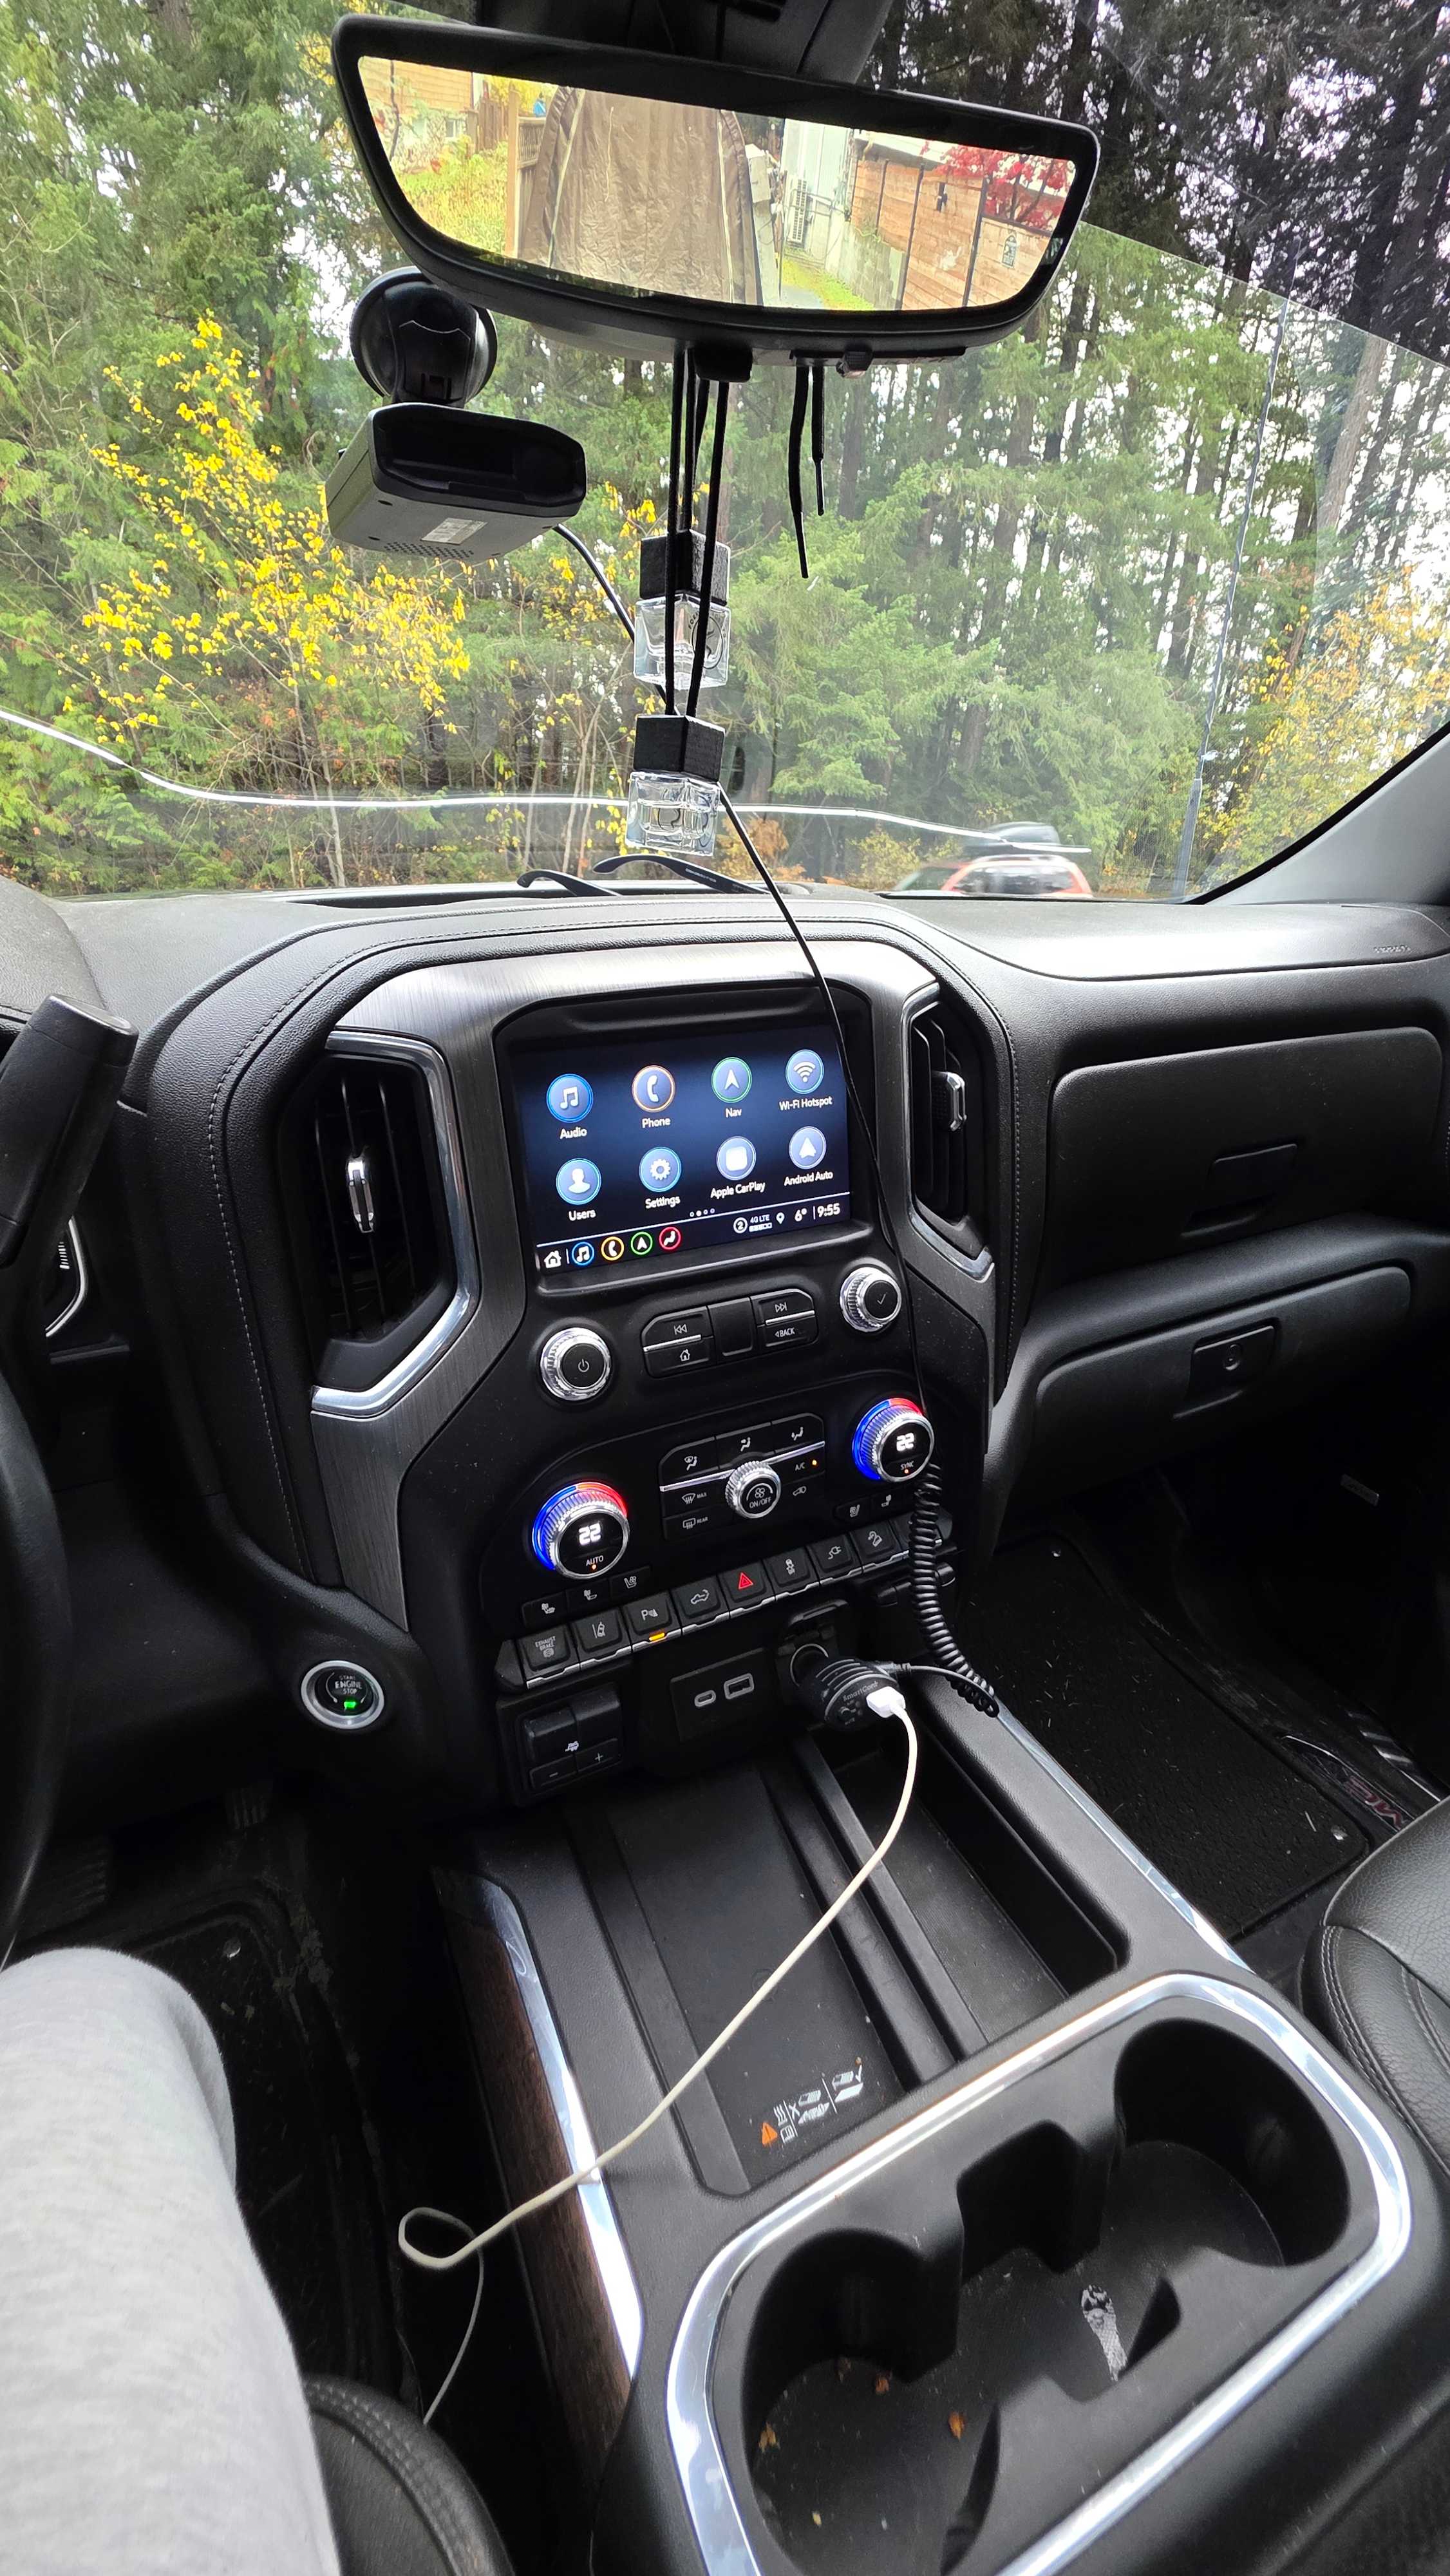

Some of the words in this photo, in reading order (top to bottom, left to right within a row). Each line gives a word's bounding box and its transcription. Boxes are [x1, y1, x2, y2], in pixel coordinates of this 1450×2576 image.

[779, 1099, 800, 1111] Wi-Fi
[801, 1095, 833, 1108] Hotspot
[725, 1107, 742, 1118] Nav
[641, 1117, 671, 1128] Phone
[559, 1126, 588, 1139] Audio
[784, 1172, 815, 1186] Android
[815, 1170, 834, 1181] Auto
[710, 1185, 735, 1199] Apple
[735, 1181, 766, 1194] CarPlay
[645, 1195, 681, 1209] Settings
[568, 1209, 596, 1222] Users
[759, 1214, 770, 1222] LTE
[817, 1202, 840, 1218] 9:55
[780, 1327, 796, 1338] BACK
[896, 1432, 914, 1452] 22
[795, 1462, 805, 1471] A/C
[900, 1461, 914, 1470] SYNC
[749, 1496, 772, 1508] ON/OFF
[578, 1522, 601, 1546] 22
[585, 1555, 604, 1567] AUTO
[535, 1636, 556, 1647] EXHAUST
[335, 1681, 362, 1689] ENGINE
